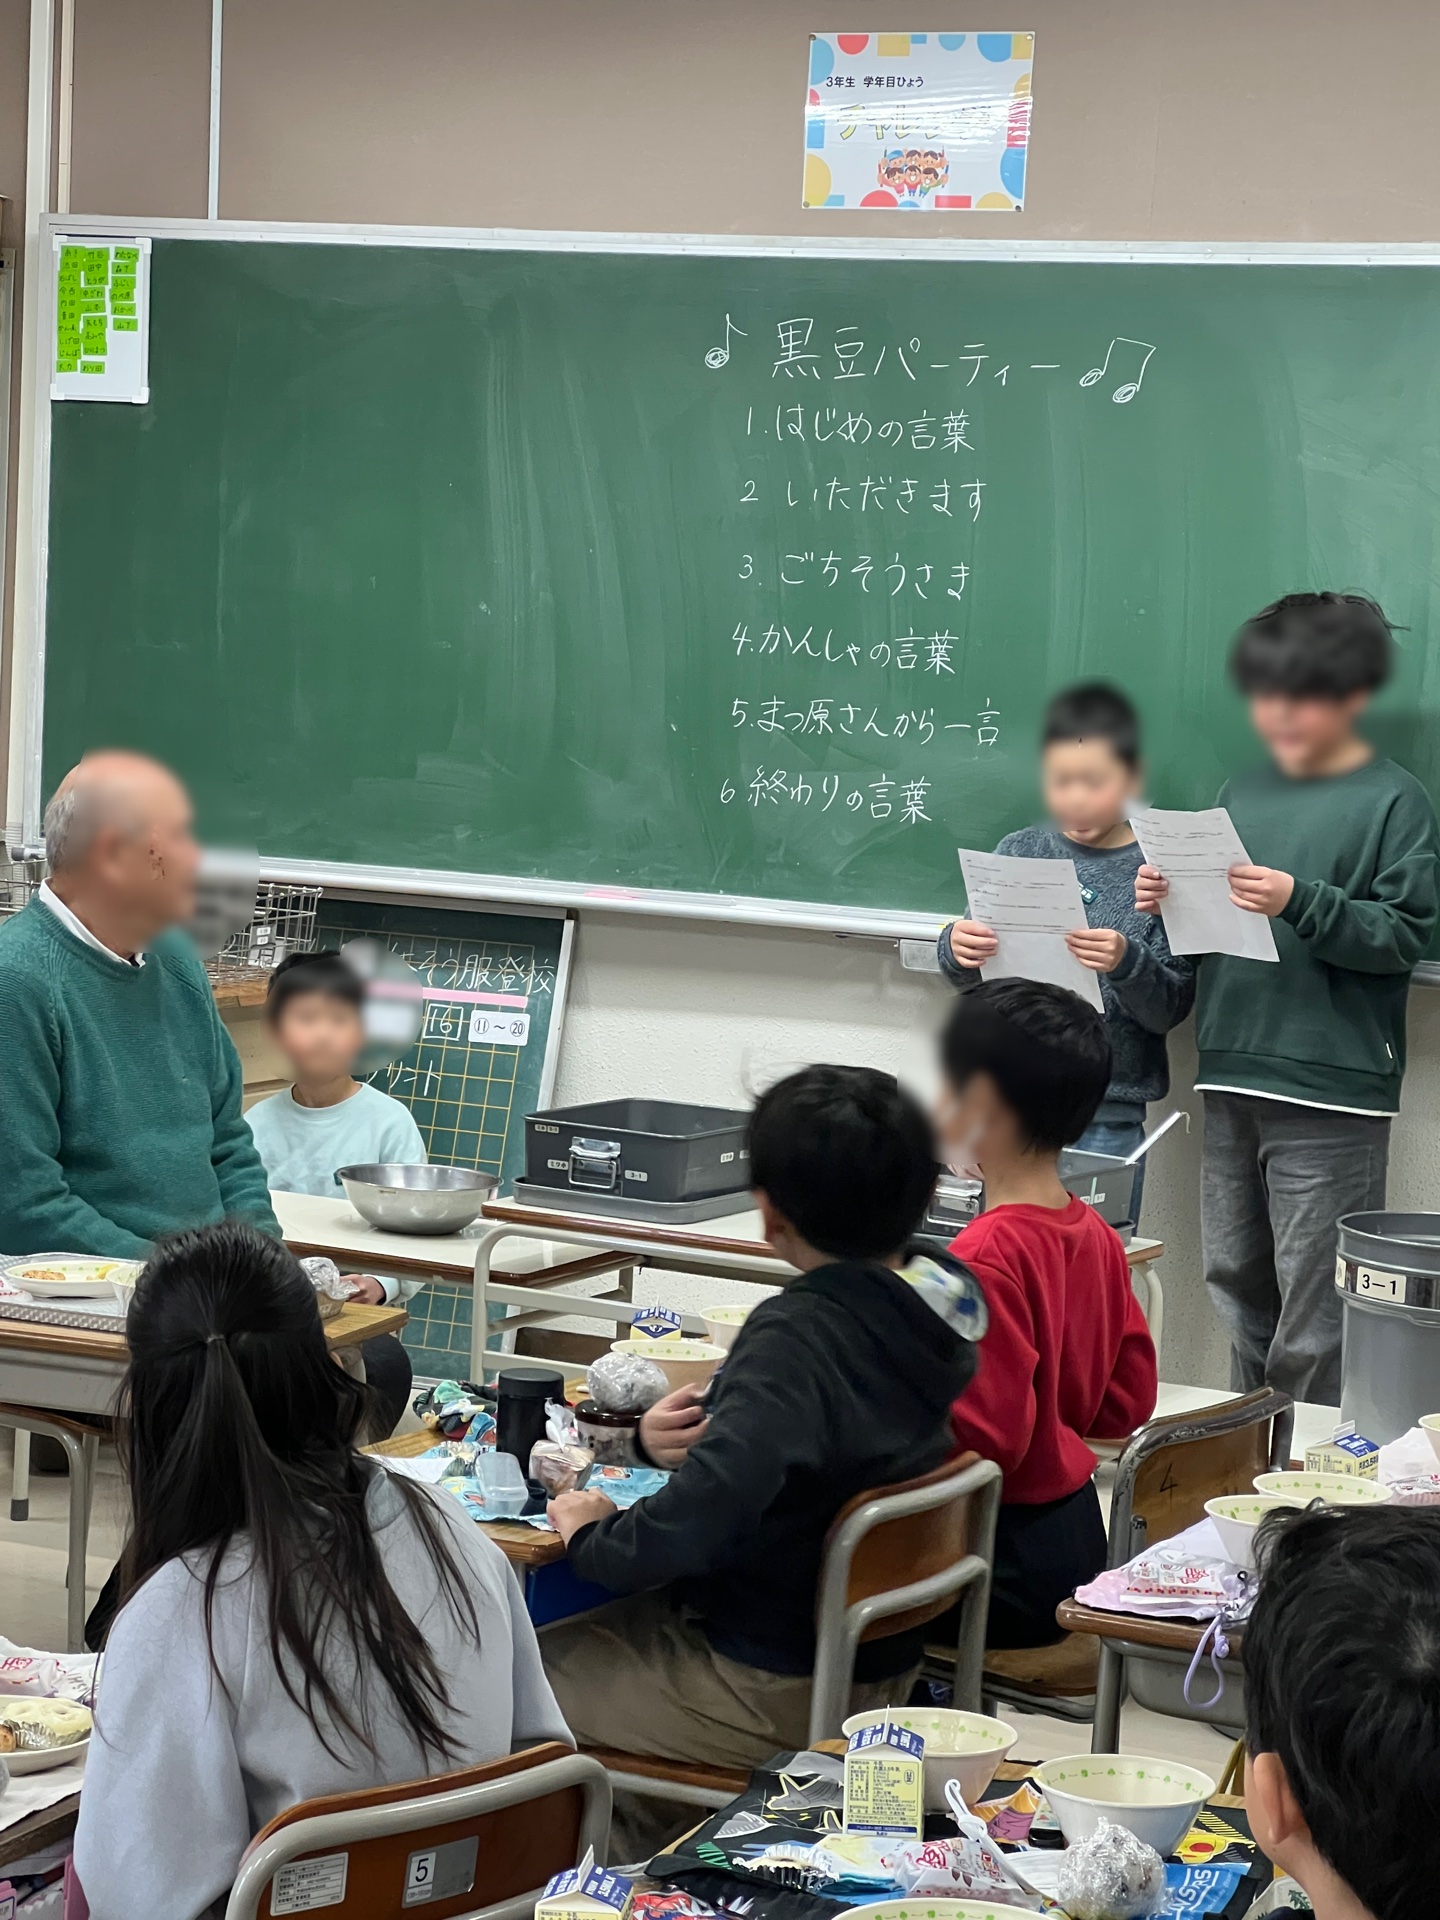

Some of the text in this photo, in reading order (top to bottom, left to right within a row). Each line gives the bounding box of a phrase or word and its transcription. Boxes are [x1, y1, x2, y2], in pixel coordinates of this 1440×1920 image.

[826, 76, 924, 88] 3年生 学年目ひょう
[87, 263, 102, 272] 田中
[117, 321, 132, 330] 山下
[771, 317, 1061, 388] 黒豆パーティー
[746, 403, 976, 454] 1.はじめの言葉
[740, 476, 988, 523] 2 いただきます
[781, 550, 972, 601] ごちそうさま
[731, 621, 960, 676] 4.かんしゃの言葉
[720, 764, 933, 825] 6 終わりの言葉
[429, 1008, 452, 1035] 16
[1159, 1464, 1178, 1509] 4
[415, 1857, 430, 1883] 5
